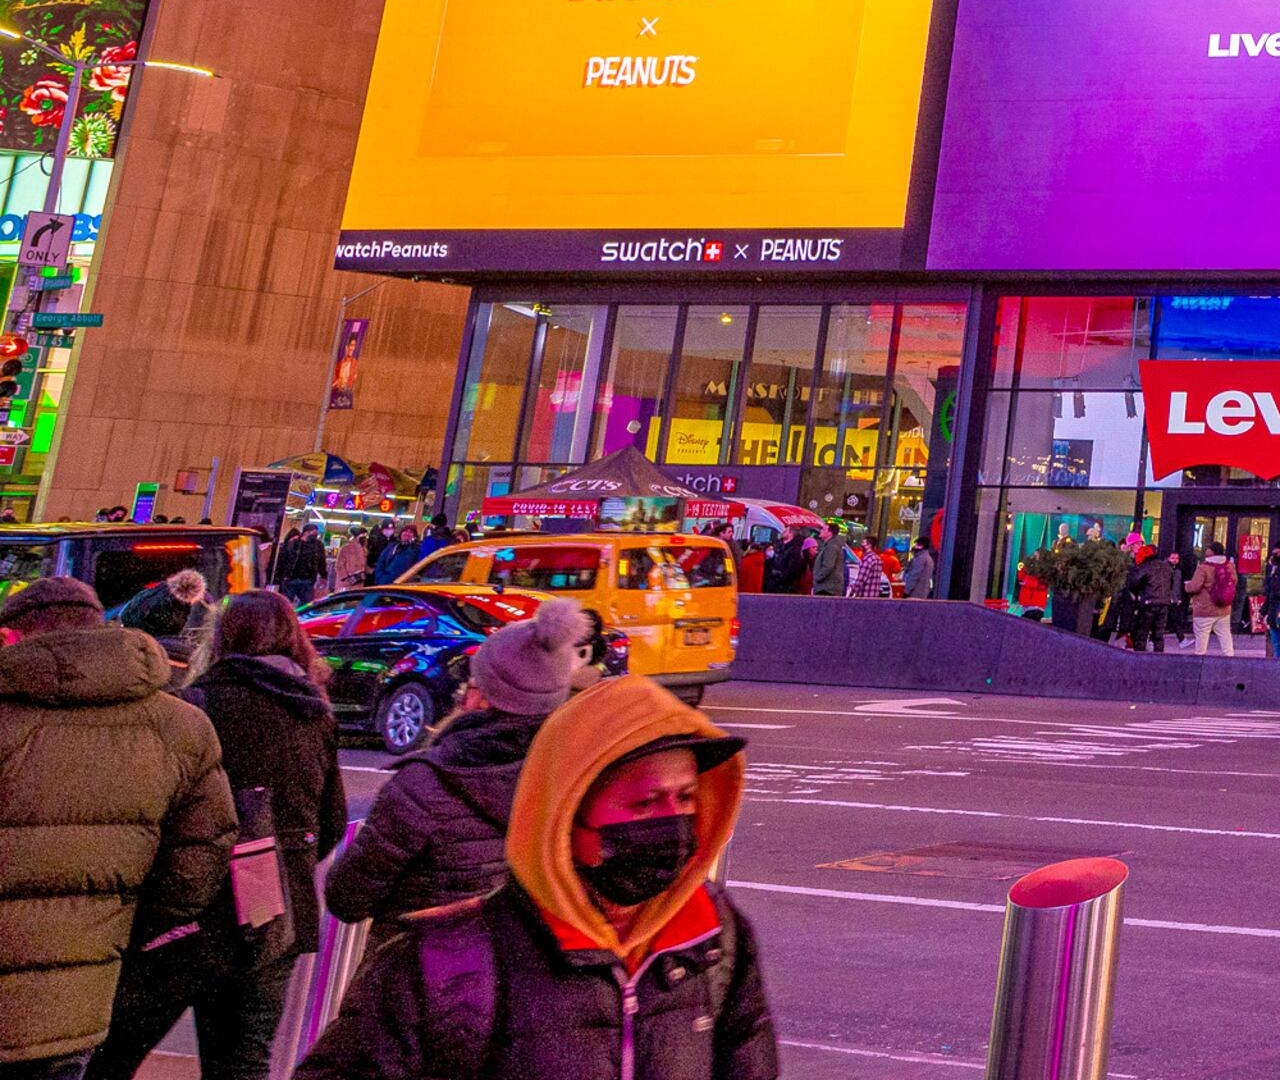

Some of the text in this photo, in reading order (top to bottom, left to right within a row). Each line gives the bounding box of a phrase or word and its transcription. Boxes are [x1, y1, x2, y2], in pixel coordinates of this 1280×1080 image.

[586, 55, 696, 86] PEANUTS
[26, 250, 60, 262] ONLY
[601, 237, 704, 262] swatch
[760, 238, 841, 262] PEANUTS
[675, 431, 709, 446] Disney
